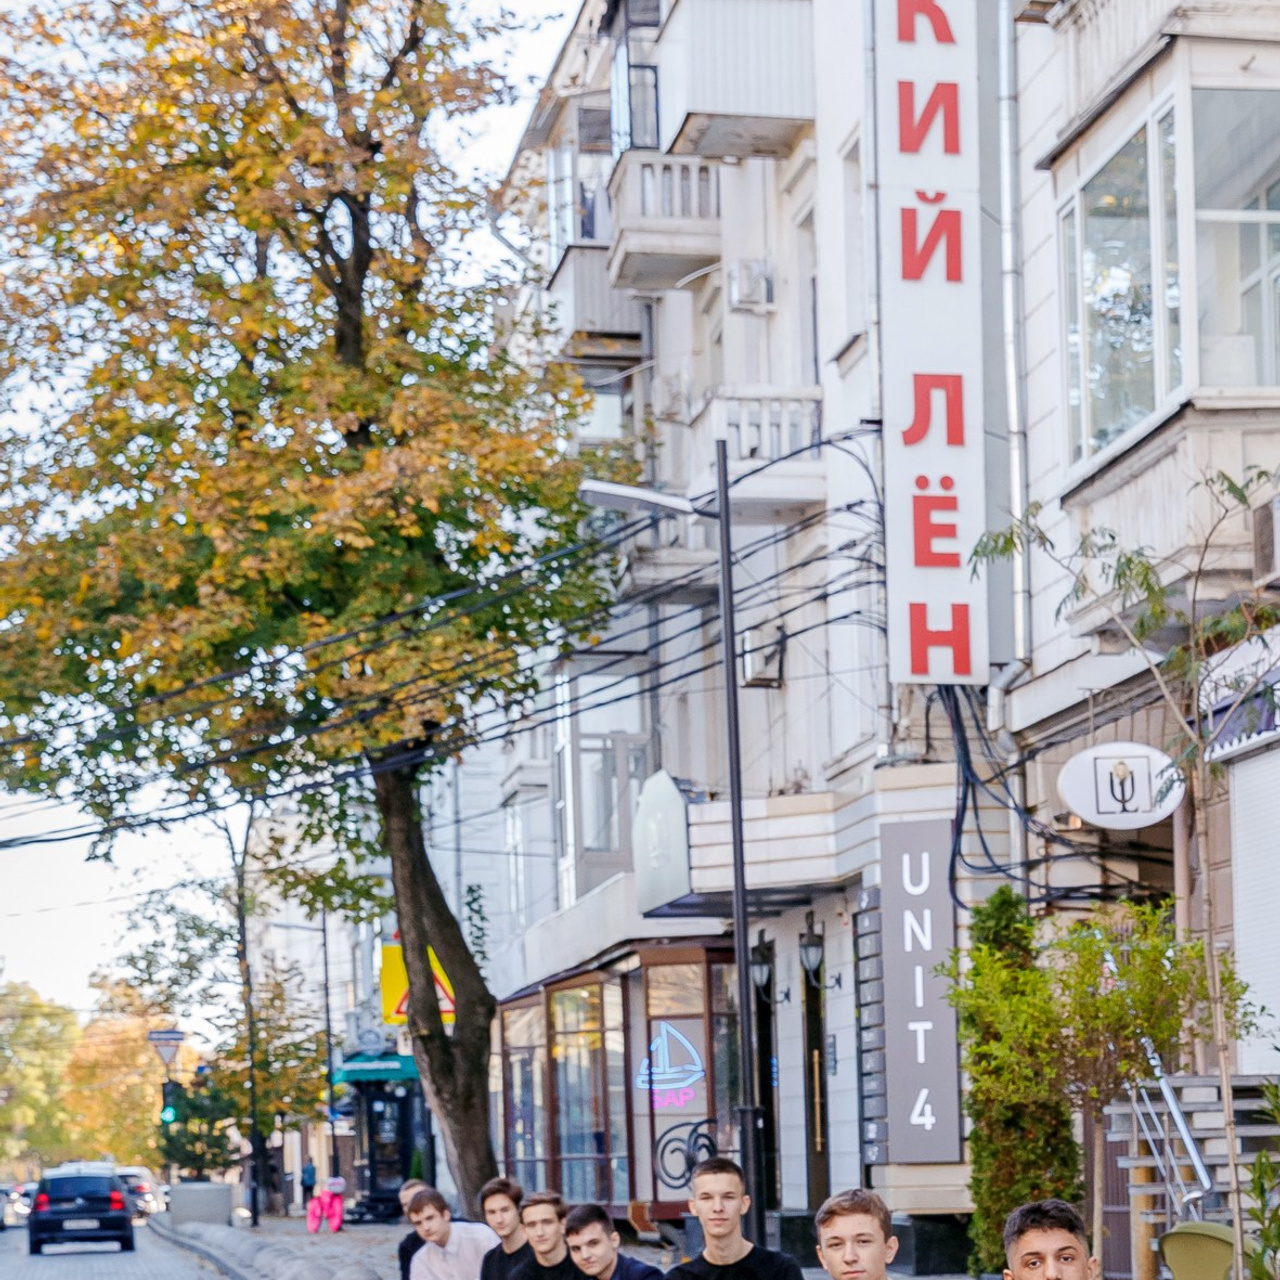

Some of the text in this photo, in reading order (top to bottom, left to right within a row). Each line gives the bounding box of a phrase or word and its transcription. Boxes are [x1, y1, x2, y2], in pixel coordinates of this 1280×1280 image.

[901, 373, 971, 675] ЛЁН
[902, 851, 936, 1131] UNIT 4
